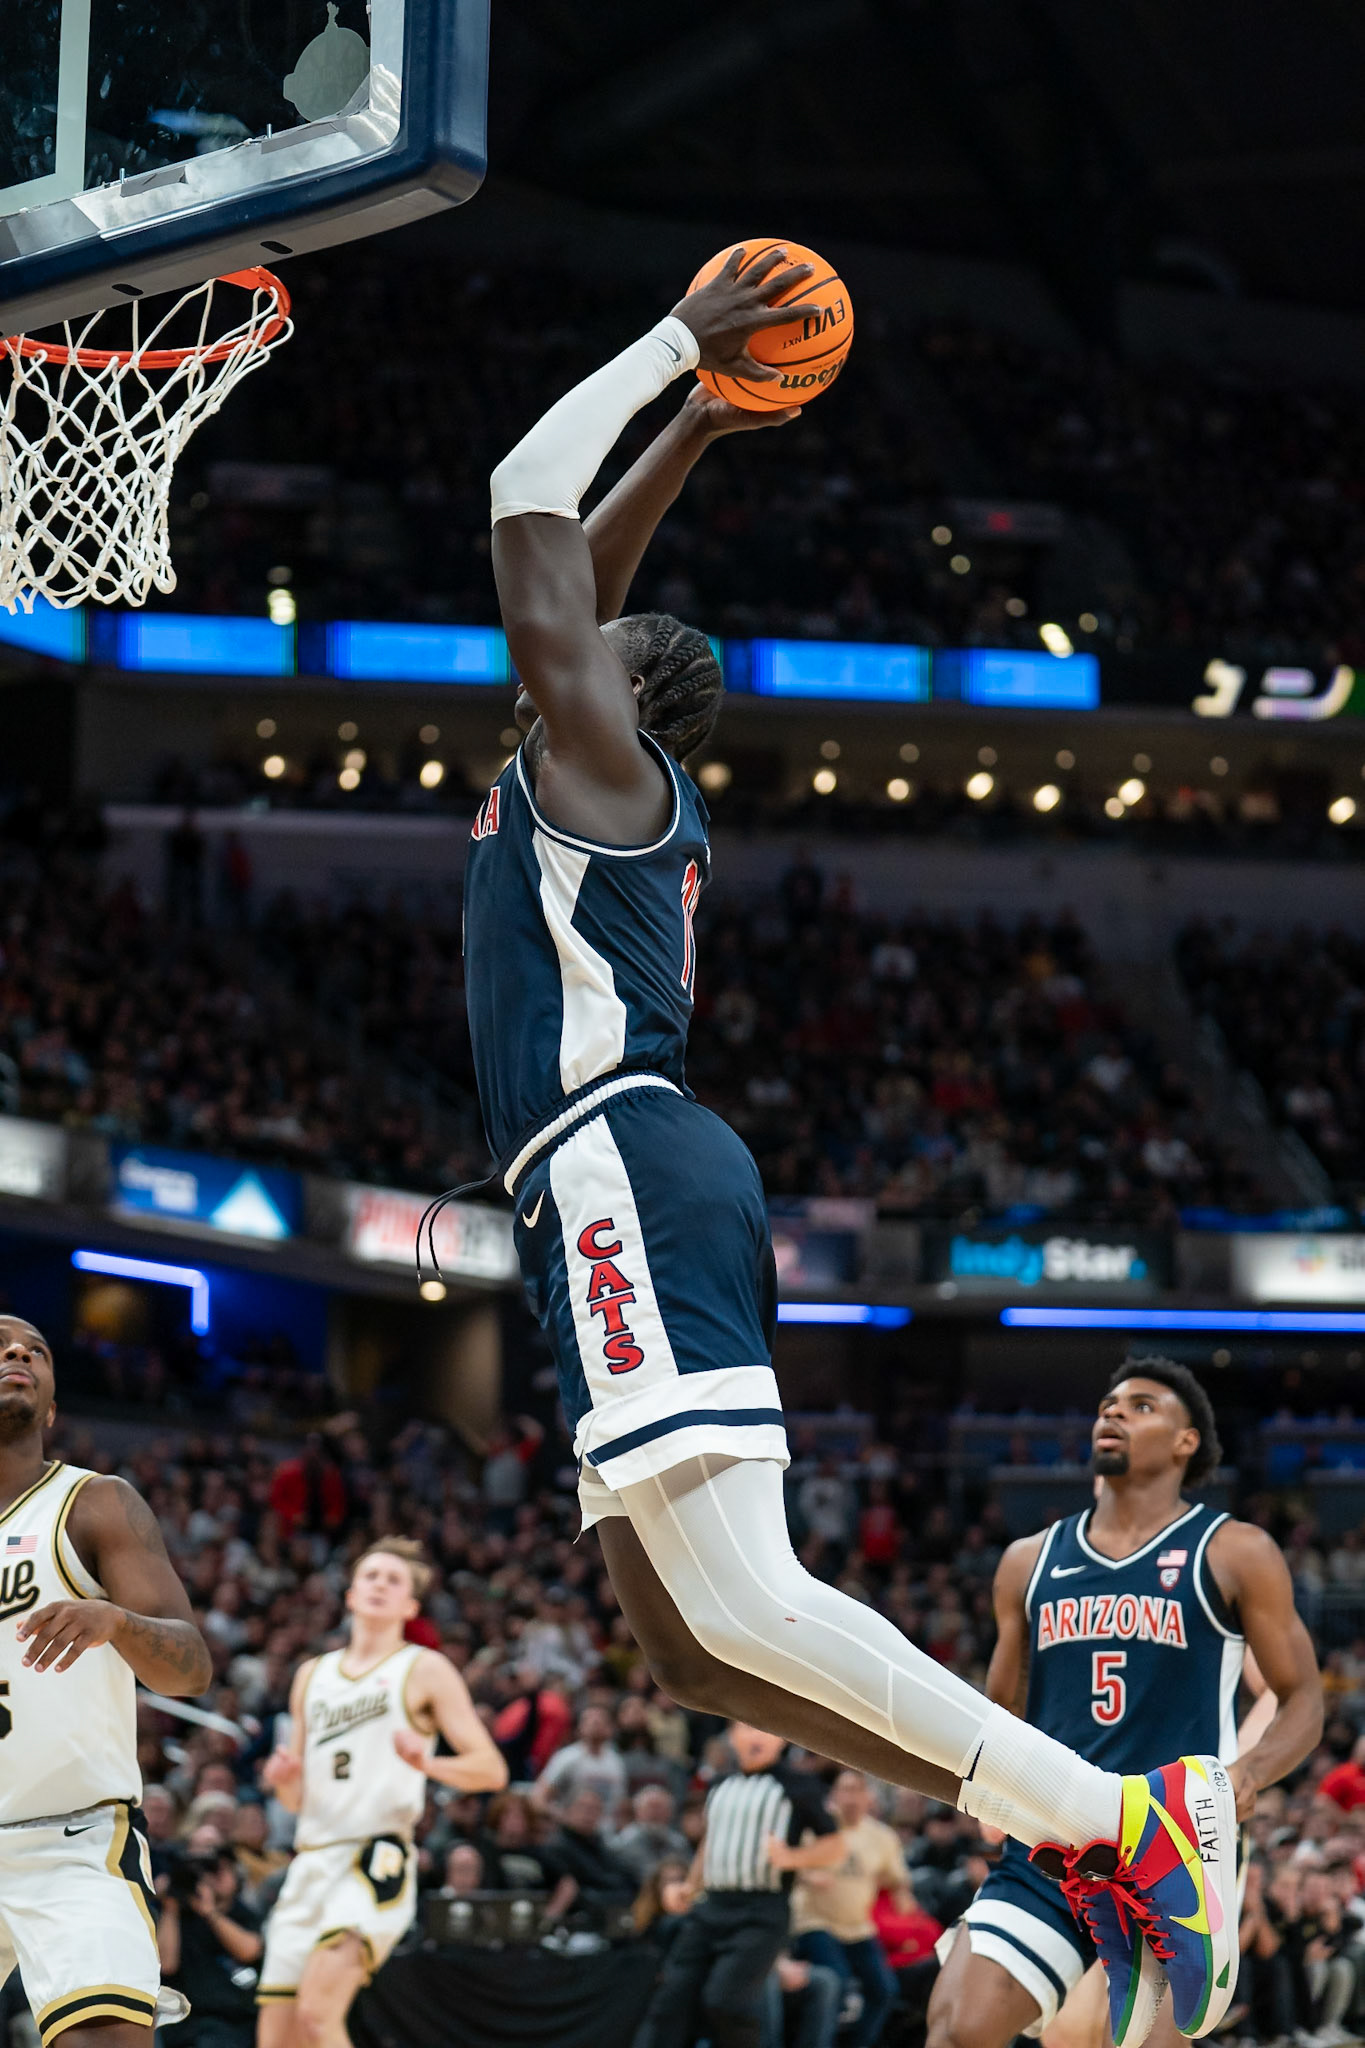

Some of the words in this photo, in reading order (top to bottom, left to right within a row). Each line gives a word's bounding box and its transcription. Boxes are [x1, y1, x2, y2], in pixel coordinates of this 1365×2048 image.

[577, 1217, 645, 1376] CATS
[1037, 1593, 1189, 1651] ARIZONA
[1091, 1650, 1127, 1726] 5
[333, 1751, 352, 1781] 2
[1194, 1797, 1221, 1864] FAITH
